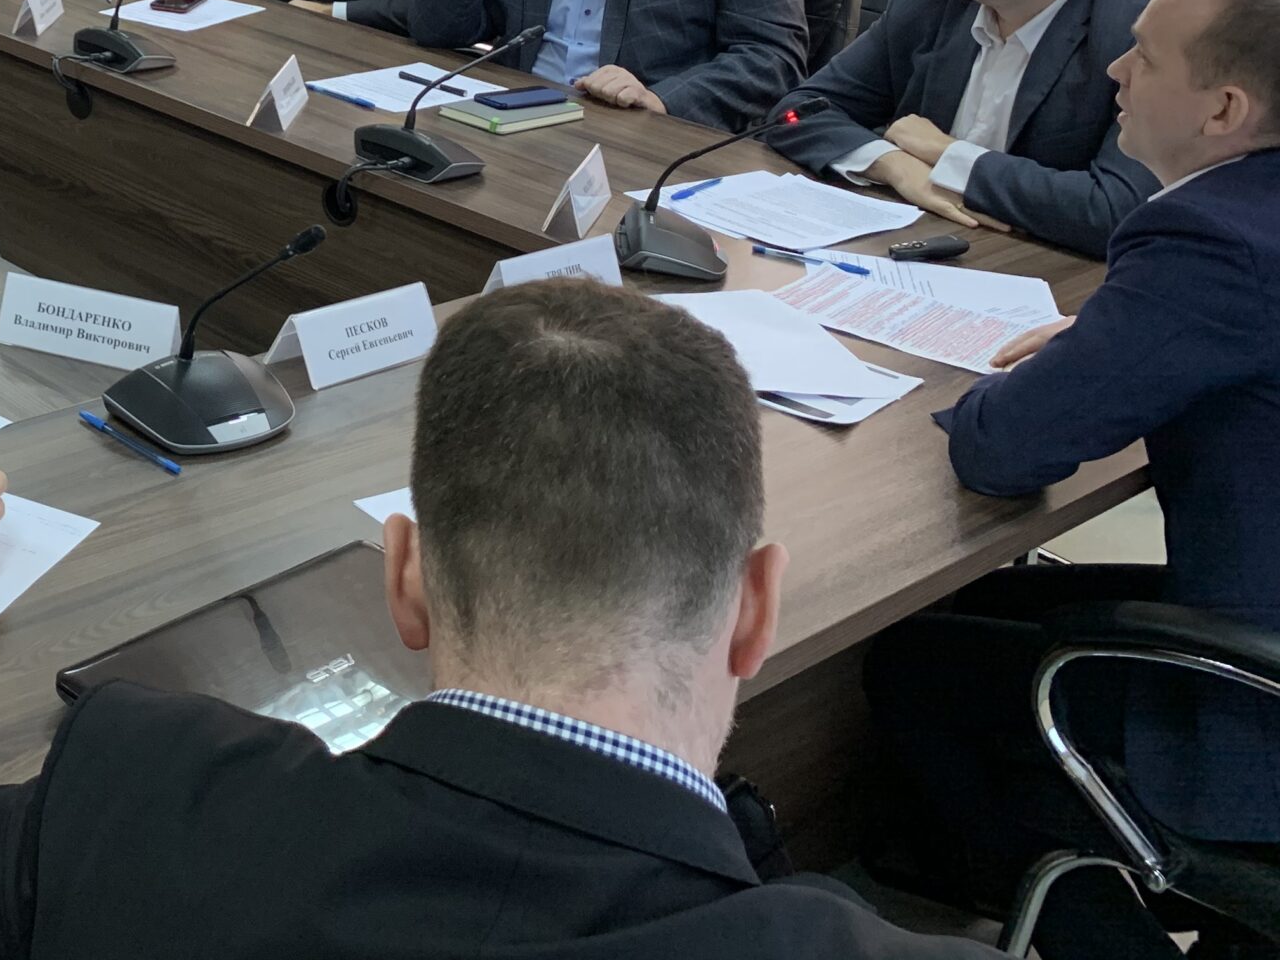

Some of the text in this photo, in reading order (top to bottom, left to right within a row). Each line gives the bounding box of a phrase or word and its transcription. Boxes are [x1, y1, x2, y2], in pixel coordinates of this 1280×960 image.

[37, 302, 132, 332] БОНДАРЕНКО
[345, 317, 389, 338] ПЕСКОВ
[14, 314, 151, 354] Владимир Викторович
[328, 329, 414, 361] Сергей Евгеньевич
